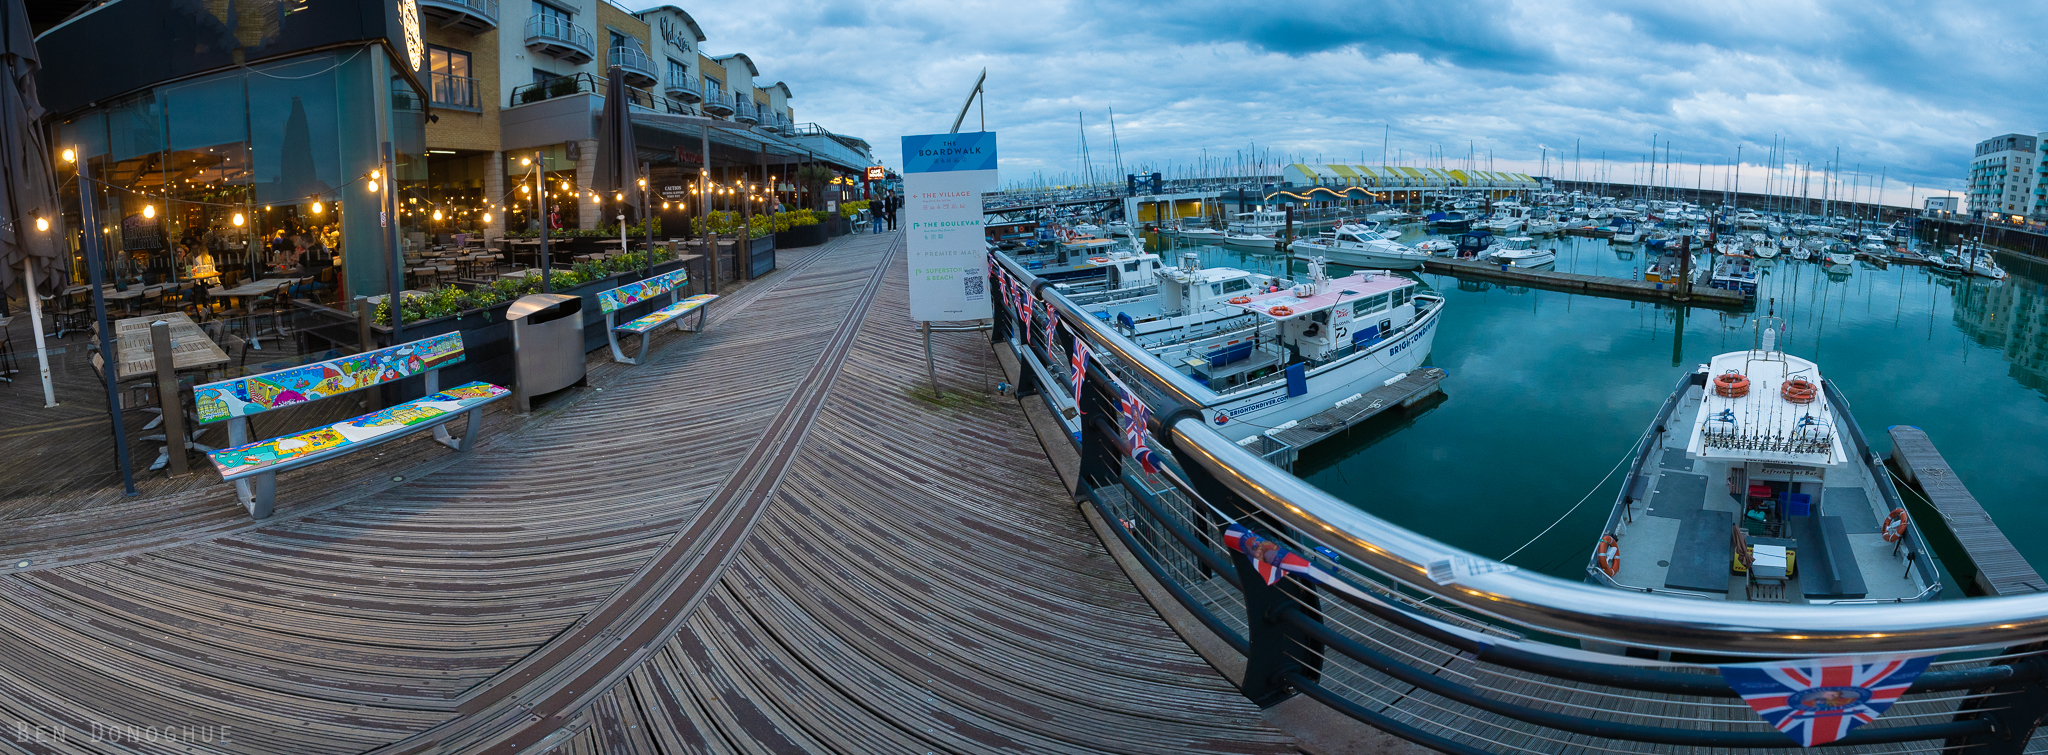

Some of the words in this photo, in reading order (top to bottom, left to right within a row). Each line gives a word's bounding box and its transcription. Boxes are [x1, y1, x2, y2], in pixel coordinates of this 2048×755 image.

[678, 146, 703, 163] Nand
[919, 147, 981, 156] BOARDWALK
[1229, 394, 1289, 417] BRIGHTONDIVER.COM
